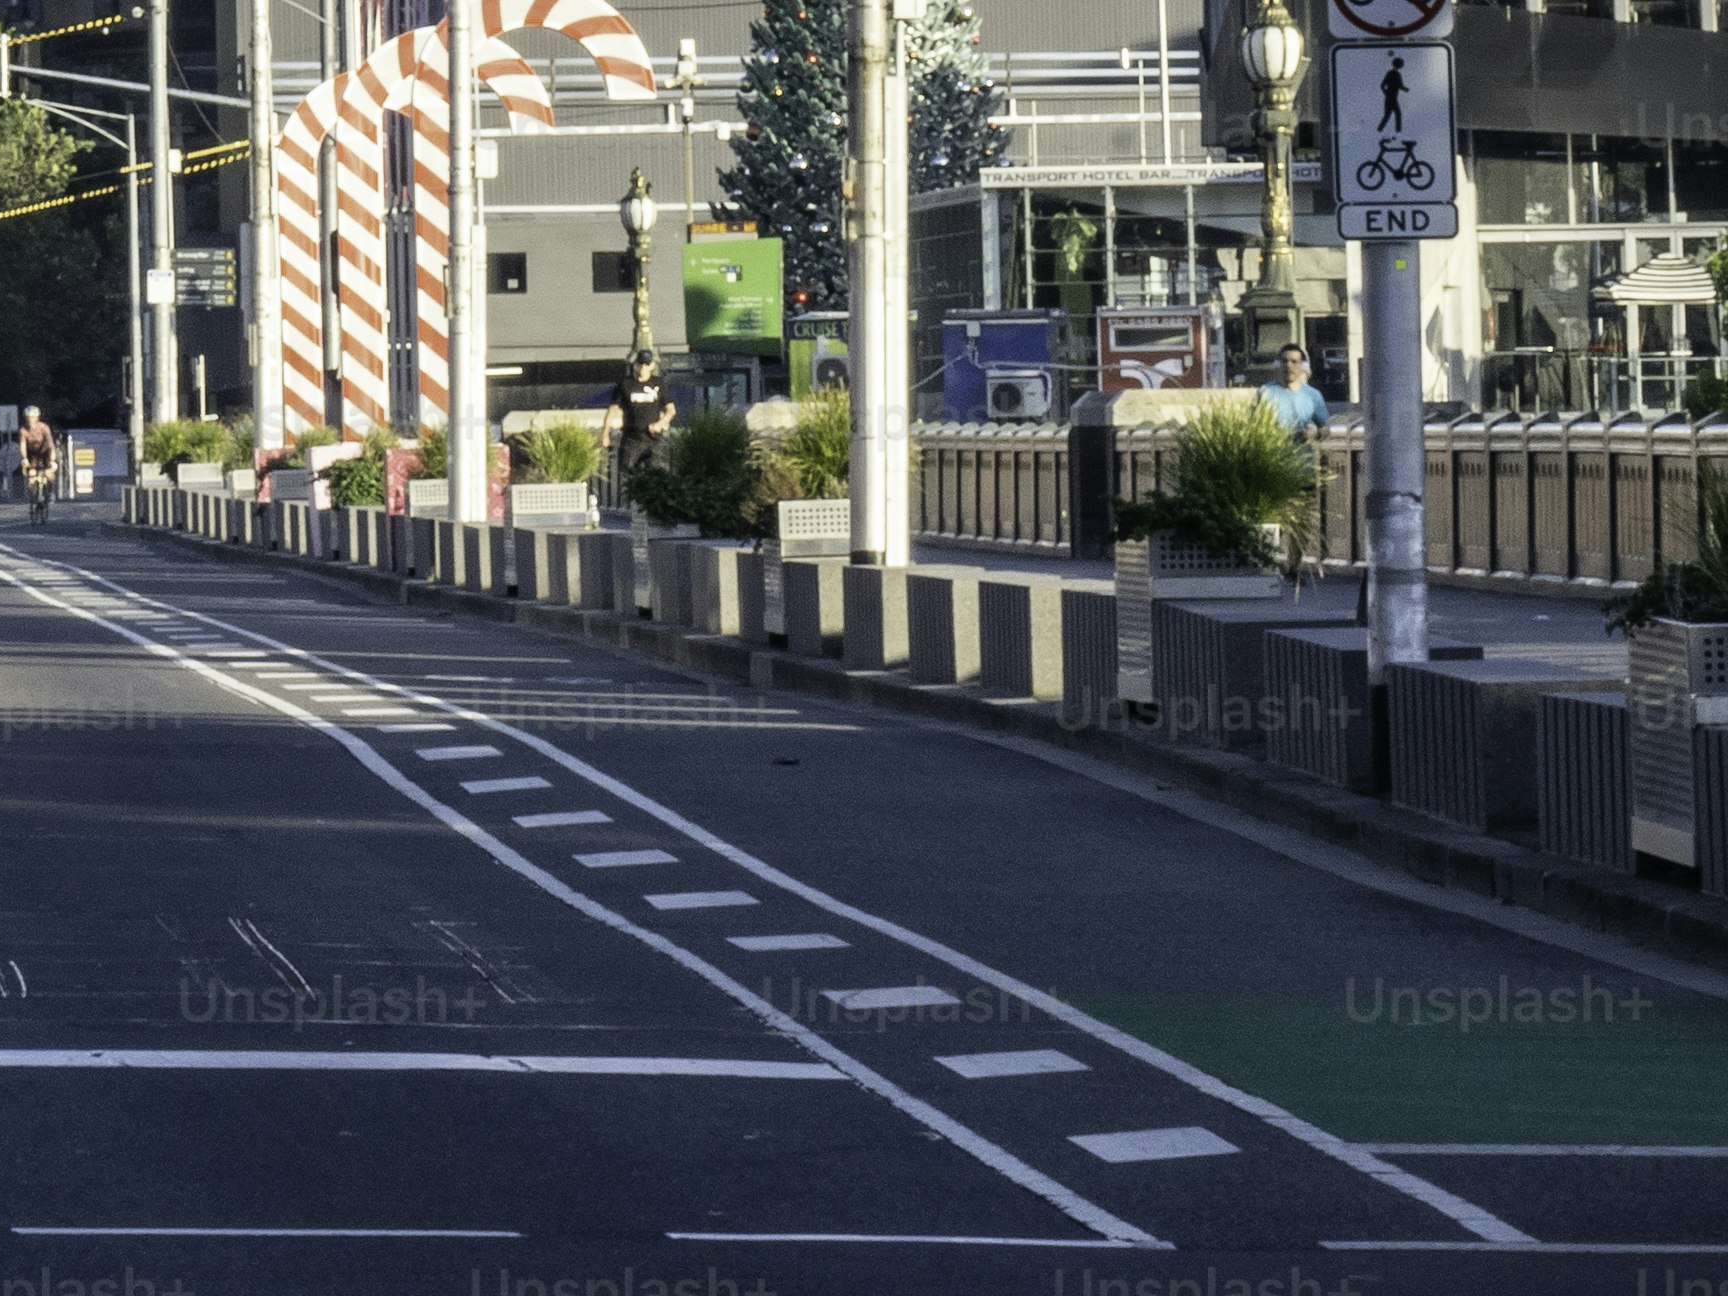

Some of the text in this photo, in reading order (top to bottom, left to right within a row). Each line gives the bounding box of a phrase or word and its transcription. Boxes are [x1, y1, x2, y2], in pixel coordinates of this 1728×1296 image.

[984, 171, 1078, 183] TRANSPORT
[1082, 171, 1134, 182] HOTEL
[1139, 170, 1171, 180] BAR
[1185, 169, 1265, 180] TRANSPO
[1366, 210, 1430, 233] END
